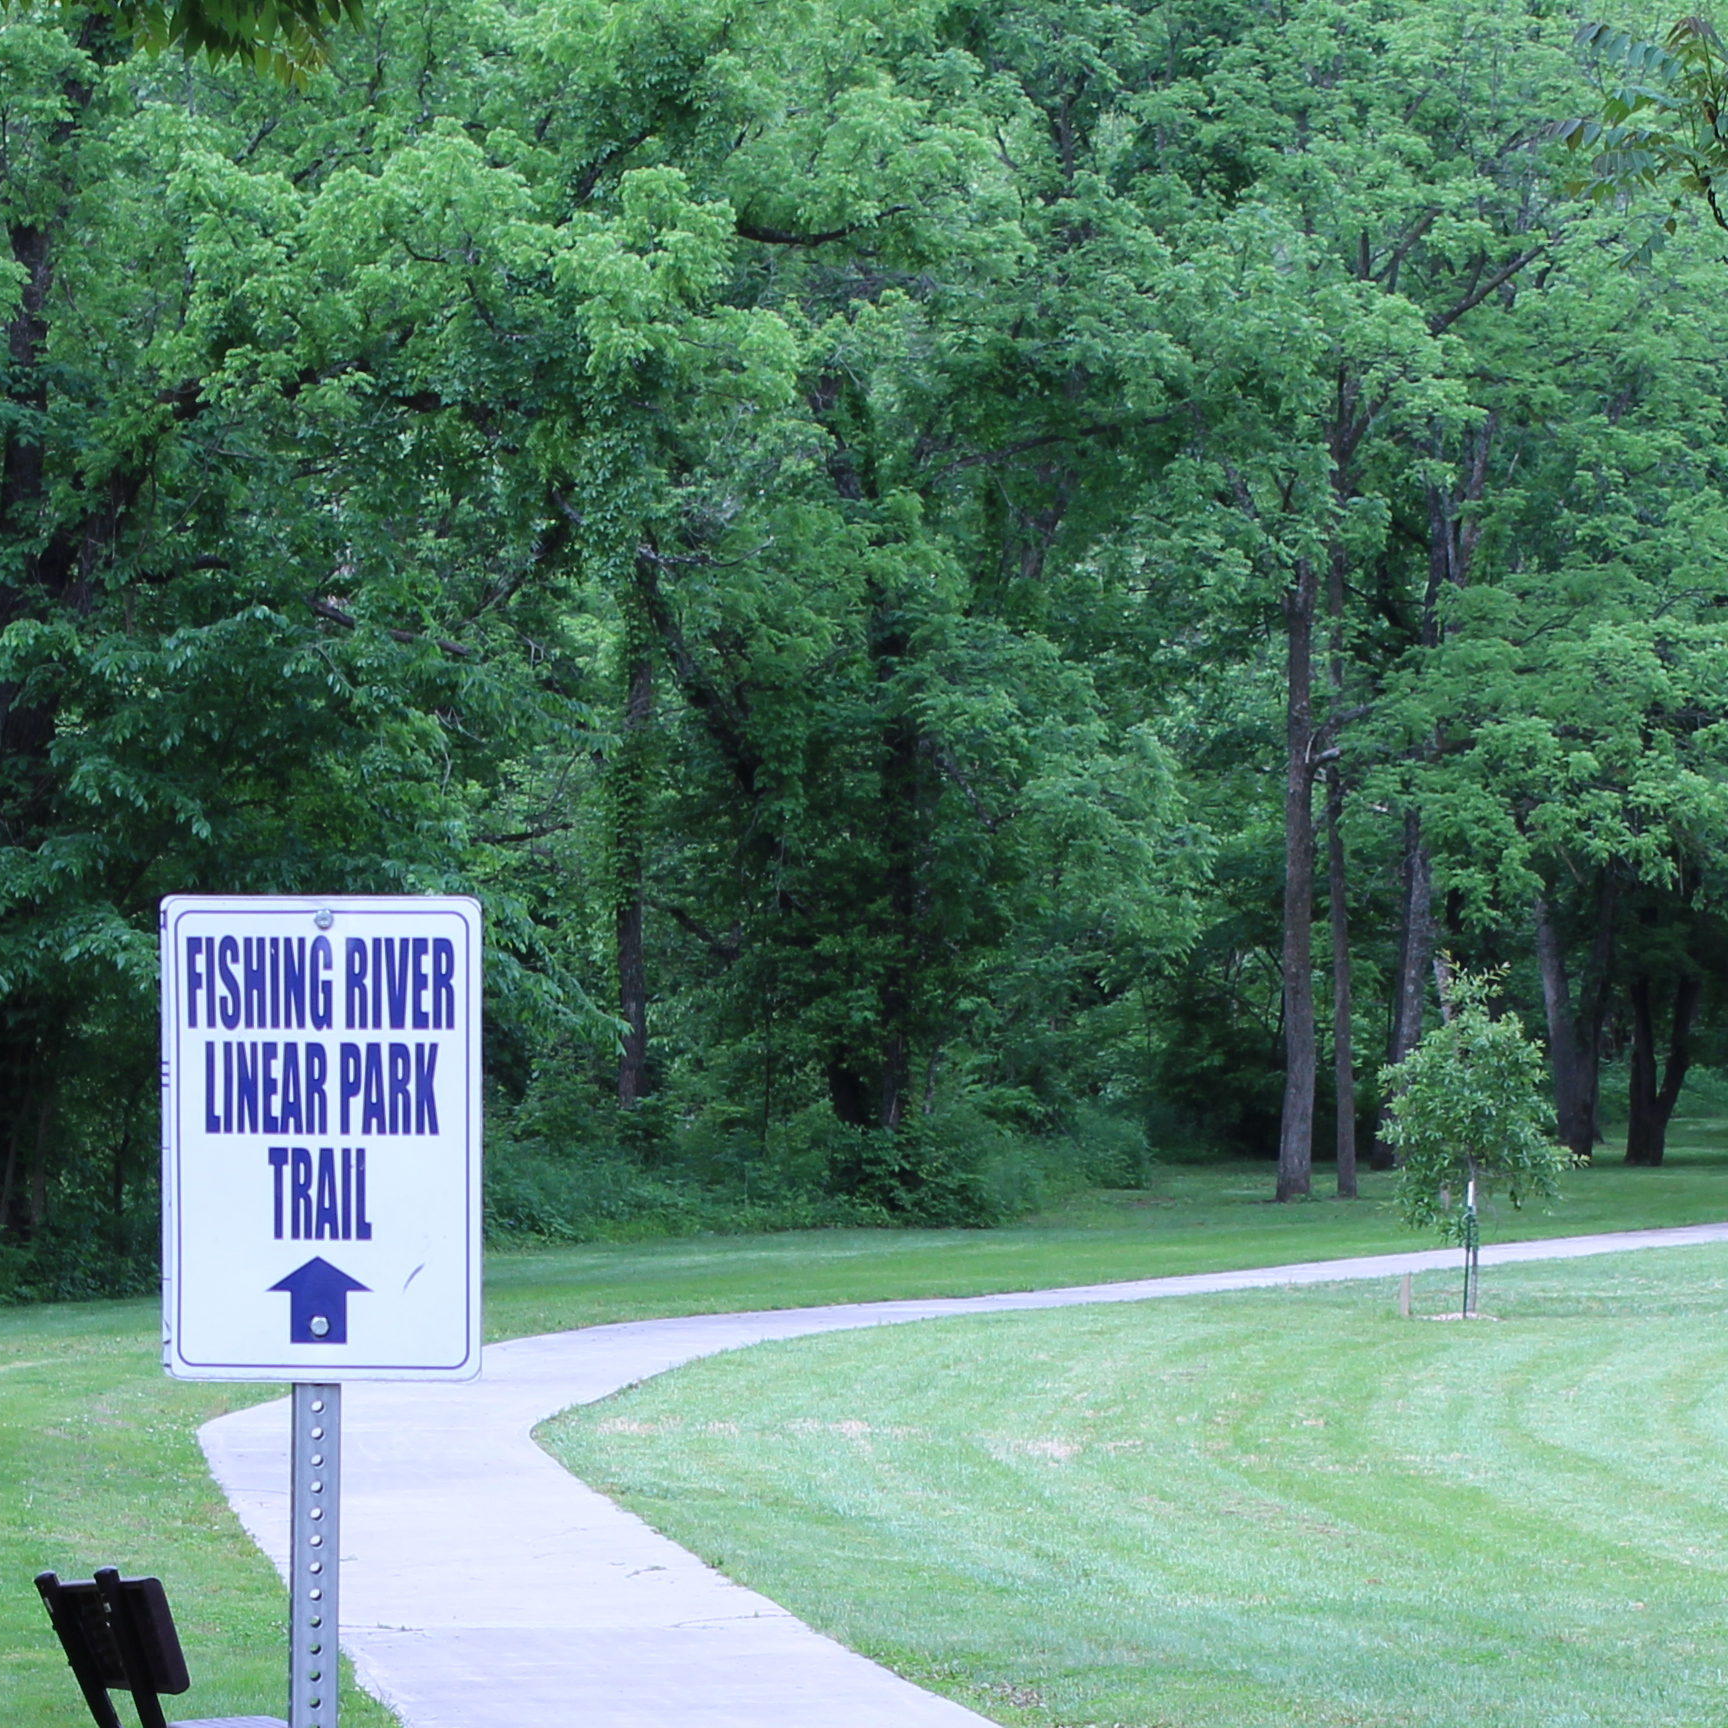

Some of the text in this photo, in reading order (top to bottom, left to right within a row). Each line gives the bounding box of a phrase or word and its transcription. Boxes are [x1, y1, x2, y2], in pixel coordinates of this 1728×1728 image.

[186, 935, 455, 1030] FISHING RIVER
[205, 1041, 440, 1135] LINEAR PARK
[268, 1147, 372, 1240] TRAIL
